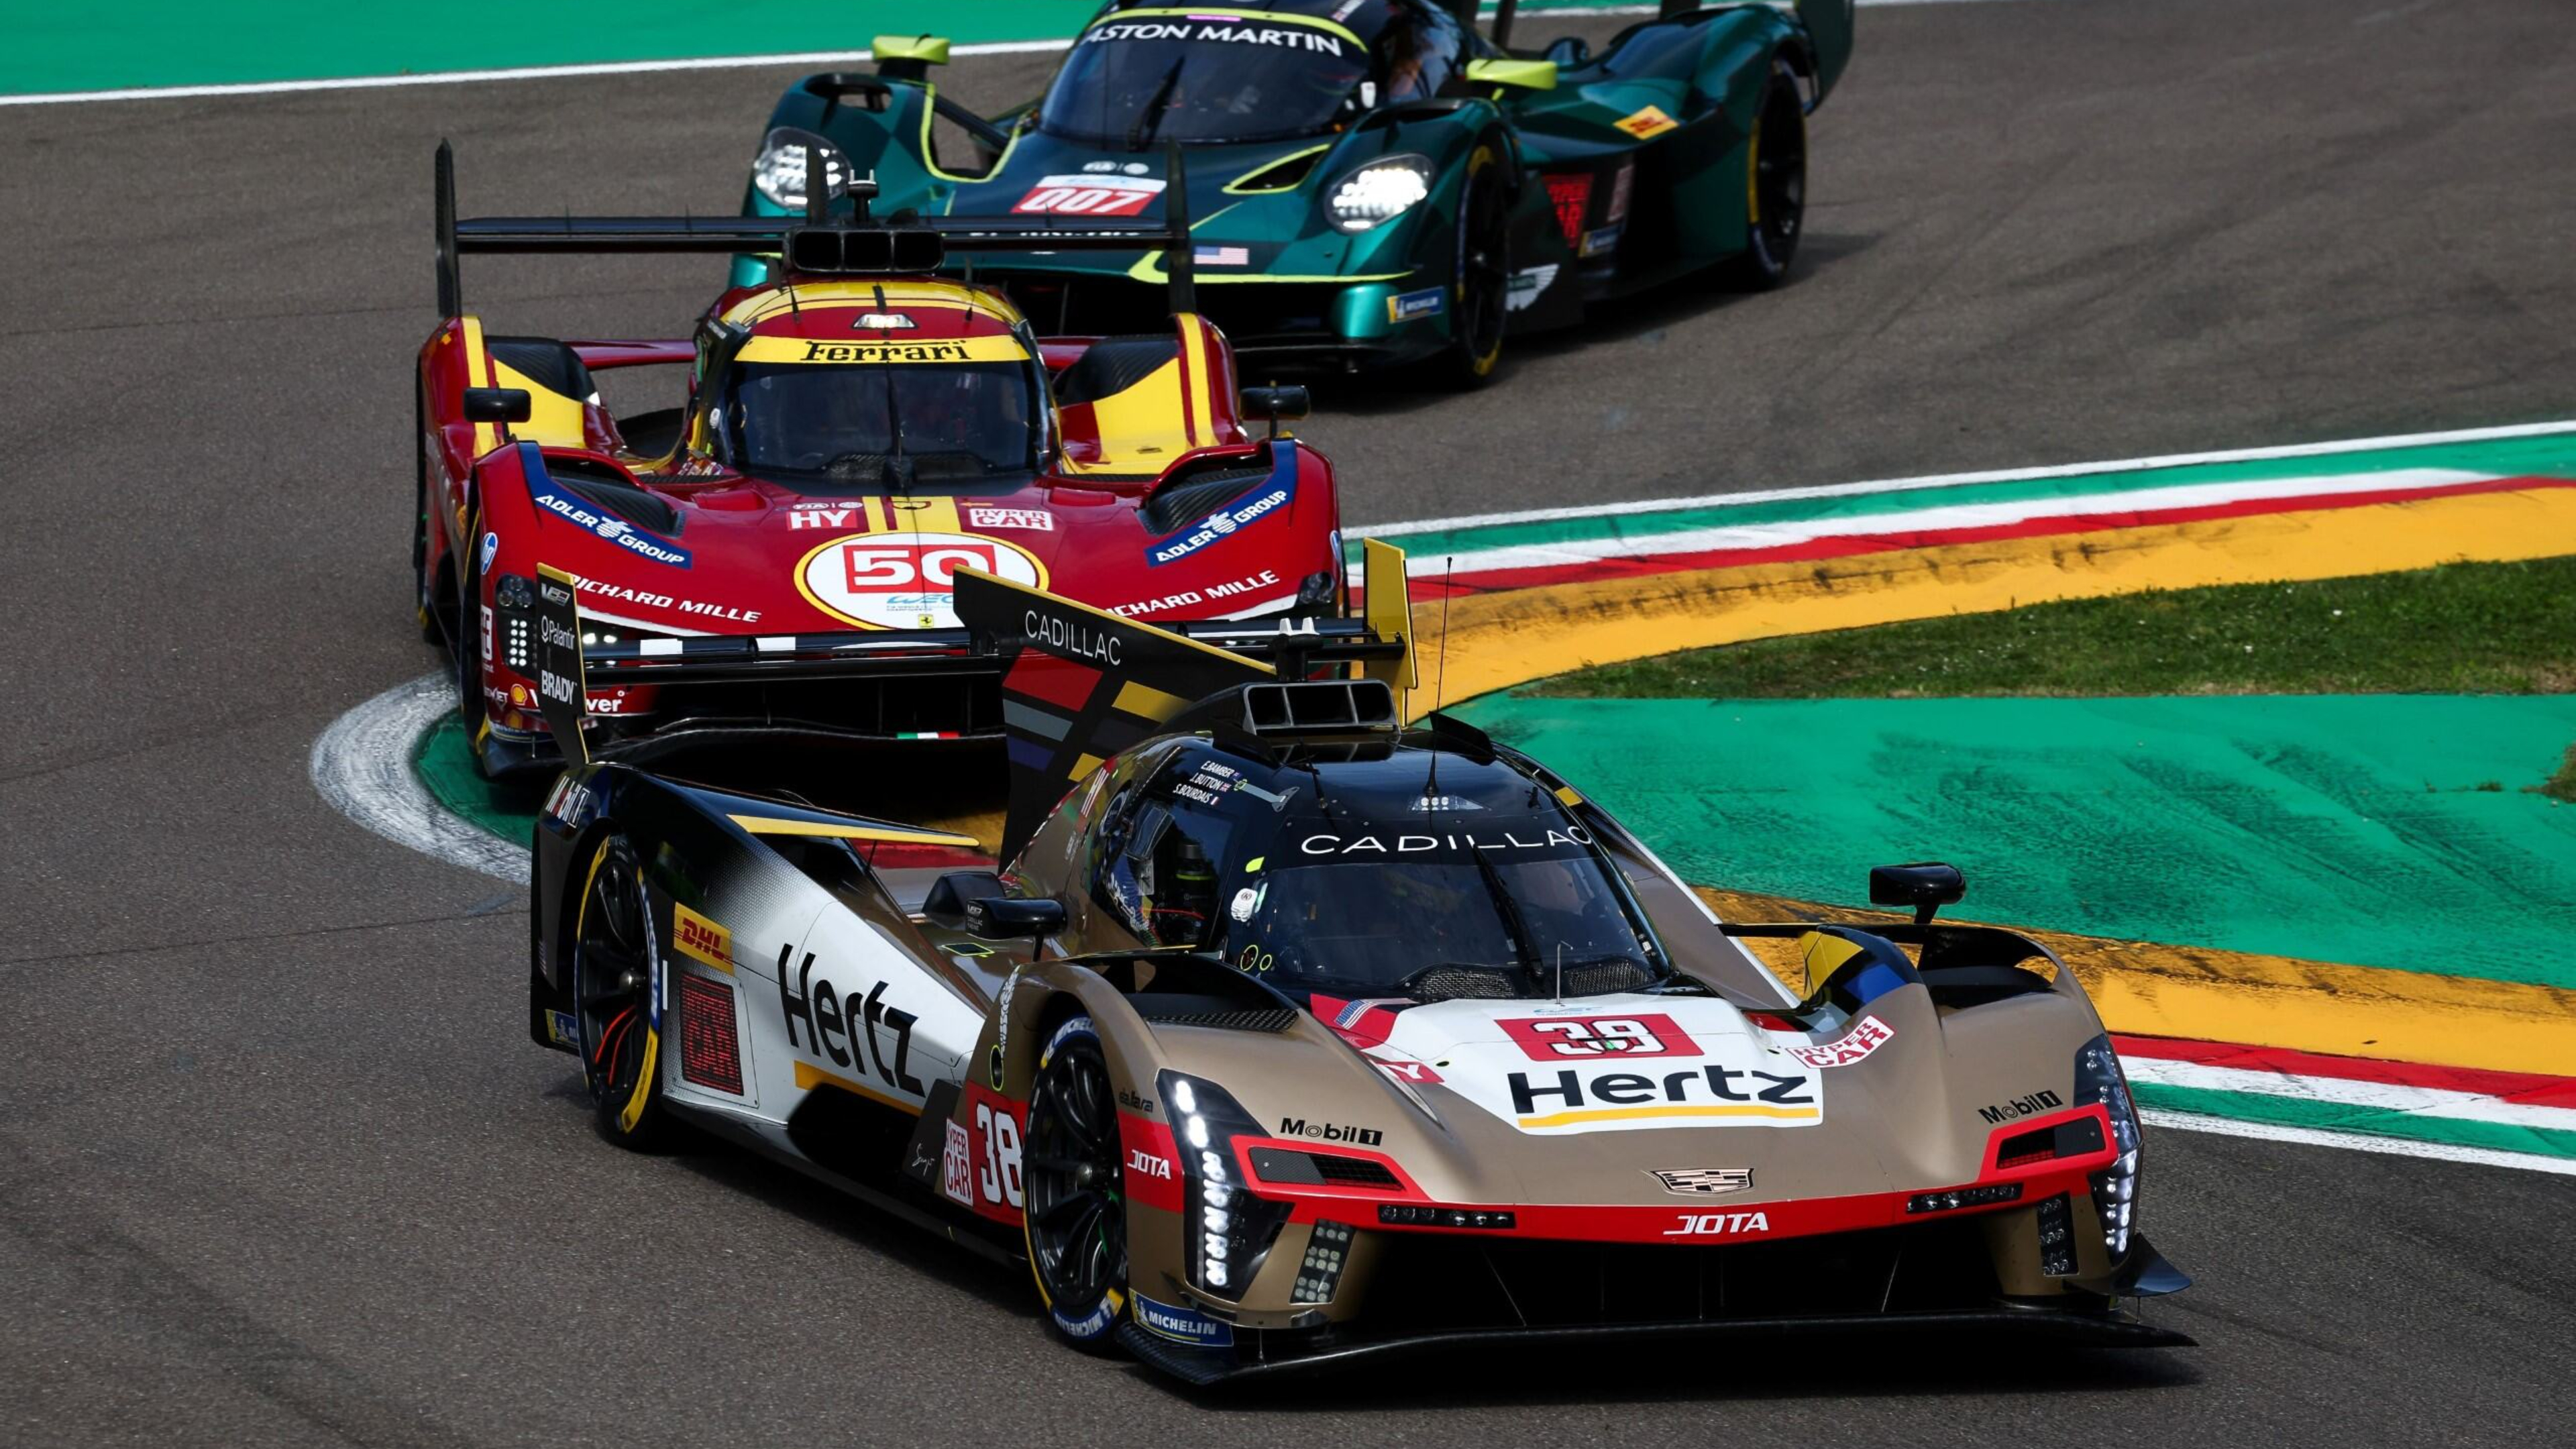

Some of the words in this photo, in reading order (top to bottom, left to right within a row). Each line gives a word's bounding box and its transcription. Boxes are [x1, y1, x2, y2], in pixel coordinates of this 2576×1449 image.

[1082, 23, 1191, 44] ASTON
[1197, 25, 1342, 56] MARTIN
[1020, 187, 1150, 213] 007
[800, 340, 971, 362] Ferrari
[535, 494, 599, 528] ADLER
[617, 533, 685, 564] GROUP
[790, 509, 851, 529] HY
[975, 510, 1046, 519] HYPER
[976, 516, 1047, 528] CAR
[1155, 529, 1218, 562] ADLER
[1232, 490, 1287, 523] GROUP
[852, 549, 989, 586] 50
[1105, 591, 1203, 616] ICHARD
[1204, 570, 1280, 600] MILLE
[678, 600, 762, 623] MILLE
[549, 619, 576, 651] Palantir
[1025, 610, 1121, 665] CADILLAC
[541, 669, 574, 705] BRADY
[1300, 826, 1592, 855] CADILLAC
[682, 917, 725, 961] DHL
[777, 943, 926, 1097] Hertz
[1794, 1022, 1872, 1056] HYPER
[1804, 1027, 1888, 1067] CAR
[1507, 1065, 1815, 1115] Hertz
[1978, 1094, 2045, 1124] Mobil
[947, 1121, 967, 1159] HYPER
[1280, 1117, 1357, 1142] Mobil
[976, 1102, 1023, 1208] 38
[1127, 1148, 1171, 1180] JOTA
[945, 1150, 971, 1199] CAR
[1662, 1212, 1769, 1236] JOTA
[1148, 1310, 1217, 1336] MICHELIN
